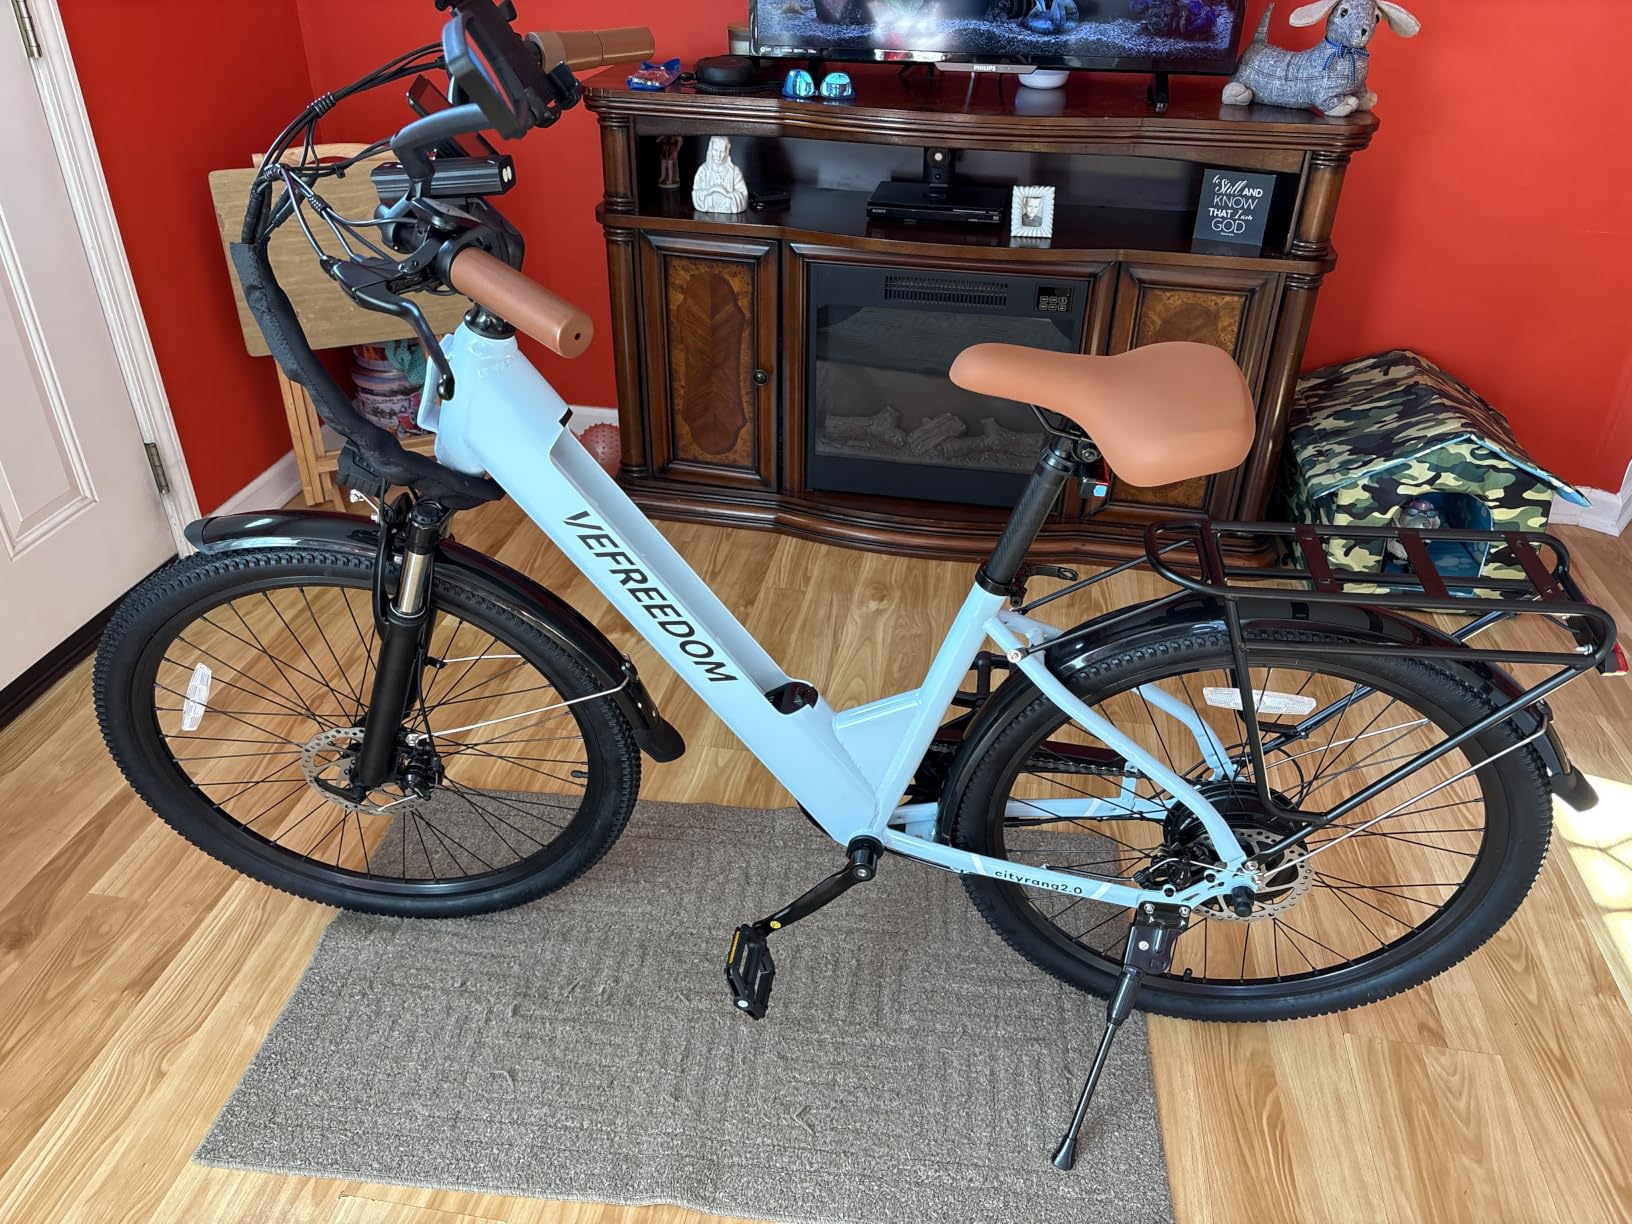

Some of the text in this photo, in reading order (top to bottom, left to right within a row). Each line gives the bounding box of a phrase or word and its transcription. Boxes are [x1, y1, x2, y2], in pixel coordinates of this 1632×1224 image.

[973, 64, 997, 72] PHILIPS
[1215, 178, 1263, 198] Still AND
[1213, 194, 1258, 210] KNOW
[1208, 207, 1233, 218] THAT
[1233, 209, 1244, 219] I
[1211, 217, 1246, 234] GOD
[562, 510, 739, 682] VEFREEDOM
